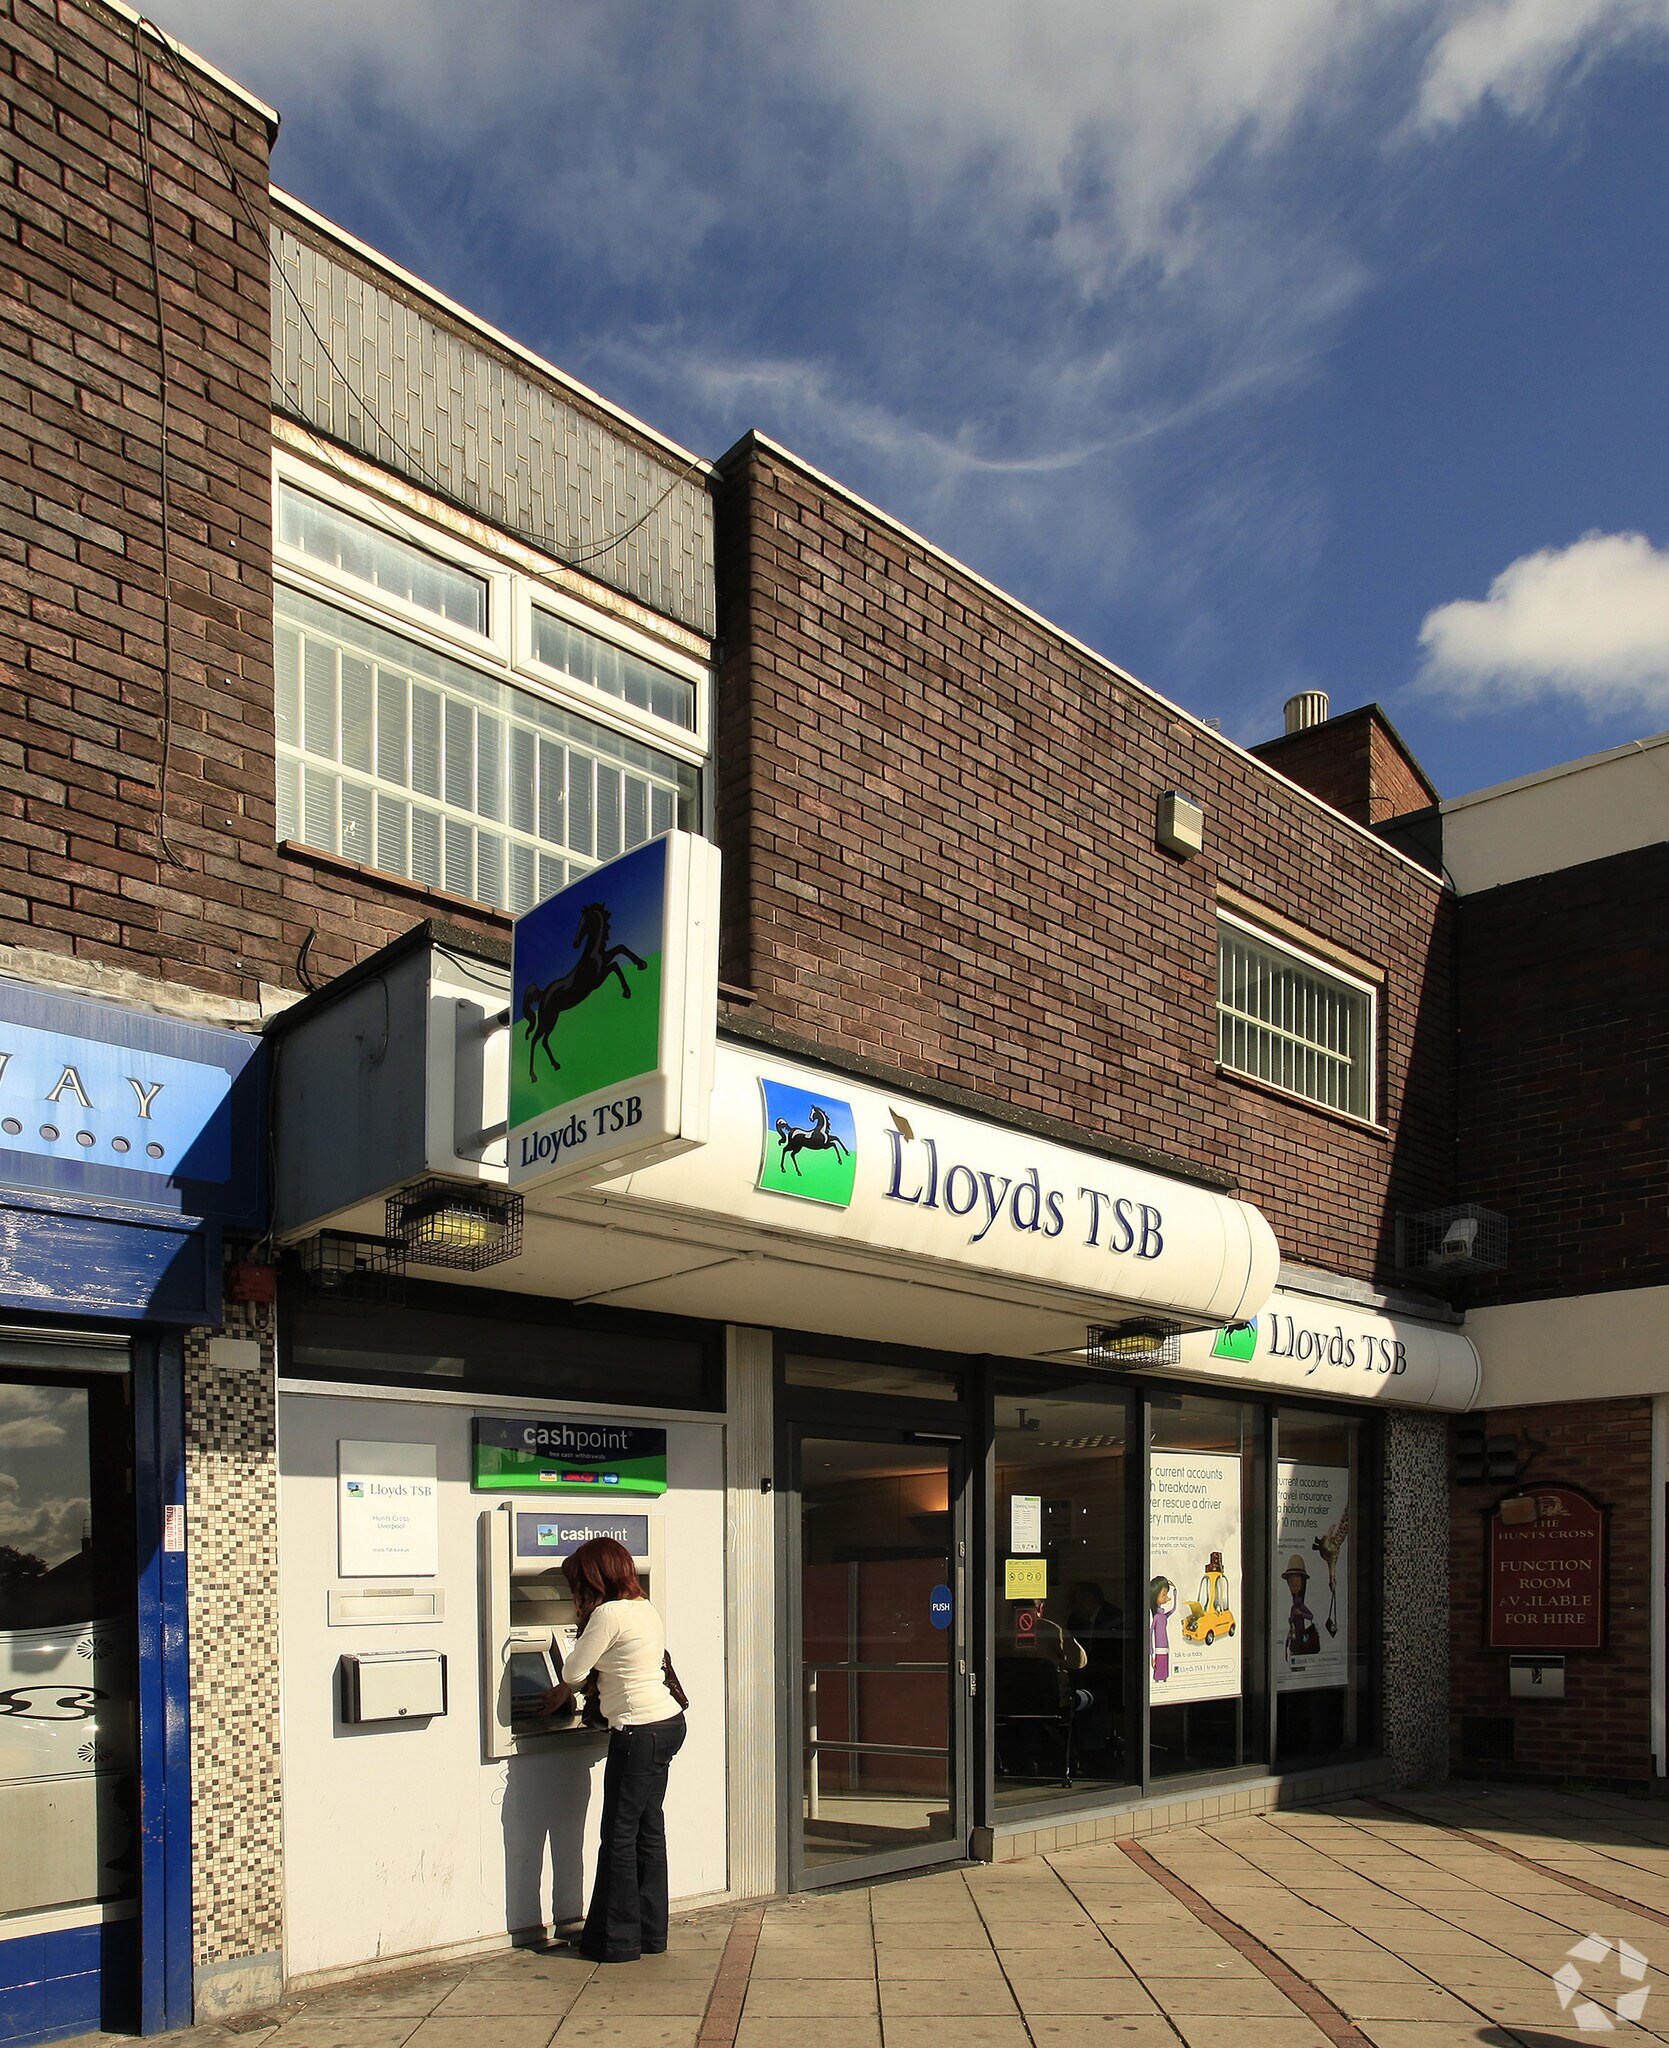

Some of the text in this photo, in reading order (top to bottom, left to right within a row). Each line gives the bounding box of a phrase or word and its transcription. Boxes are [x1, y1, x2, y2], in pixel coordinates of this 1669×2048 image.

[520, 1096, 643, 1167] Lloyds TSB
[882, 1128, 1164, 1260] Lloyds TSB
[1268, 1313, 1407, 1377] Lloyds TSB
[523, 1425, 628, 1451] cashpoint
[575, 1452, 606, 1460] withdrawals
[1155, 1467, 1185, 1478] current
[1187, 1469, 1223, 1480] accounts
[1159, 1480, 1207, 1494] breakdown
[1300, 1479, 1329, 1488] accounts
[370, 1484, 432, 1498] Lloyds TSB
[1299, 1491, 1333, 1502] insurance
[1150, 1497, 1222, 1510] er rescue a driver
[1283, 1503, 1307, 1516] holiday
[1308, 1505, 1329, 1515] maker
[1163, 1512, 1193, 1524] minute.
[1282, 1517, 1289, 1528] 10
[1499, 1529, 1594, 1540] HUNTS CROSS
[1500, 1559, 1592, 1572] FUNCTION
[1519, 1578, 1571, 1589] ROOM
[932, 1603, 950, 1611] PUSH
[1505, 1613, 1586, 1624] FOR HIRE
[1180, 1665, 1194, 1674] Lloyds
